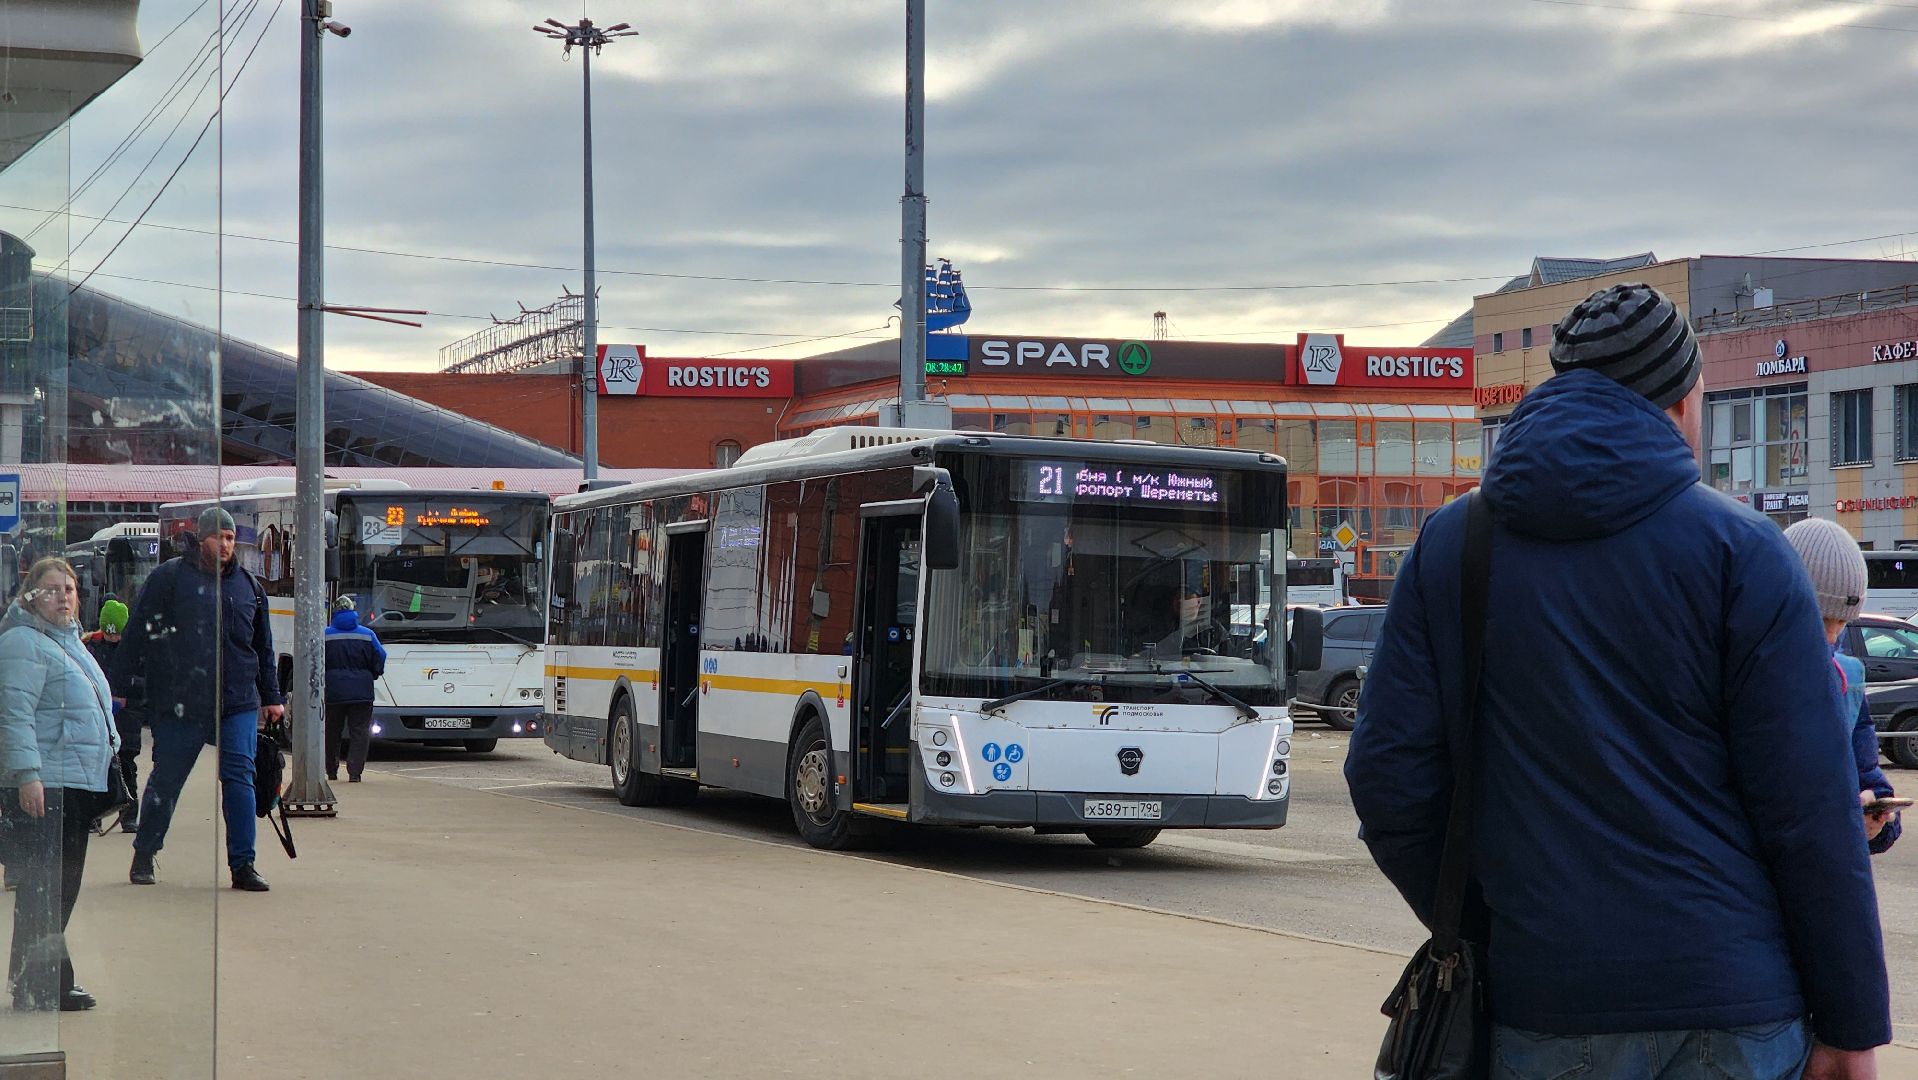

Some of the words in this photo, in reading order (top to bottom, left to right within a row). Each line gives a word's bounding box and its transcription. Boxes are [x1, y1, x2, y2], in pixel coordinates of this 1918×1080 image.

[981, 340, 1110, 369] SPAR
[1367, 356, 1464, 378] ROSTIC'S
[1755, 356, 1806, 376] ЛОМБАРД
[668, 366, 770, 387] ROSTIC'S
[1040, 466, 1063, 495] 21
[1168, 473, 1213, 489] Южный
[364, 521, 381, 536] 23
[1088, 803, 1137, 817] Х589ТТ
[1140, 802, 1158, 813] 790
